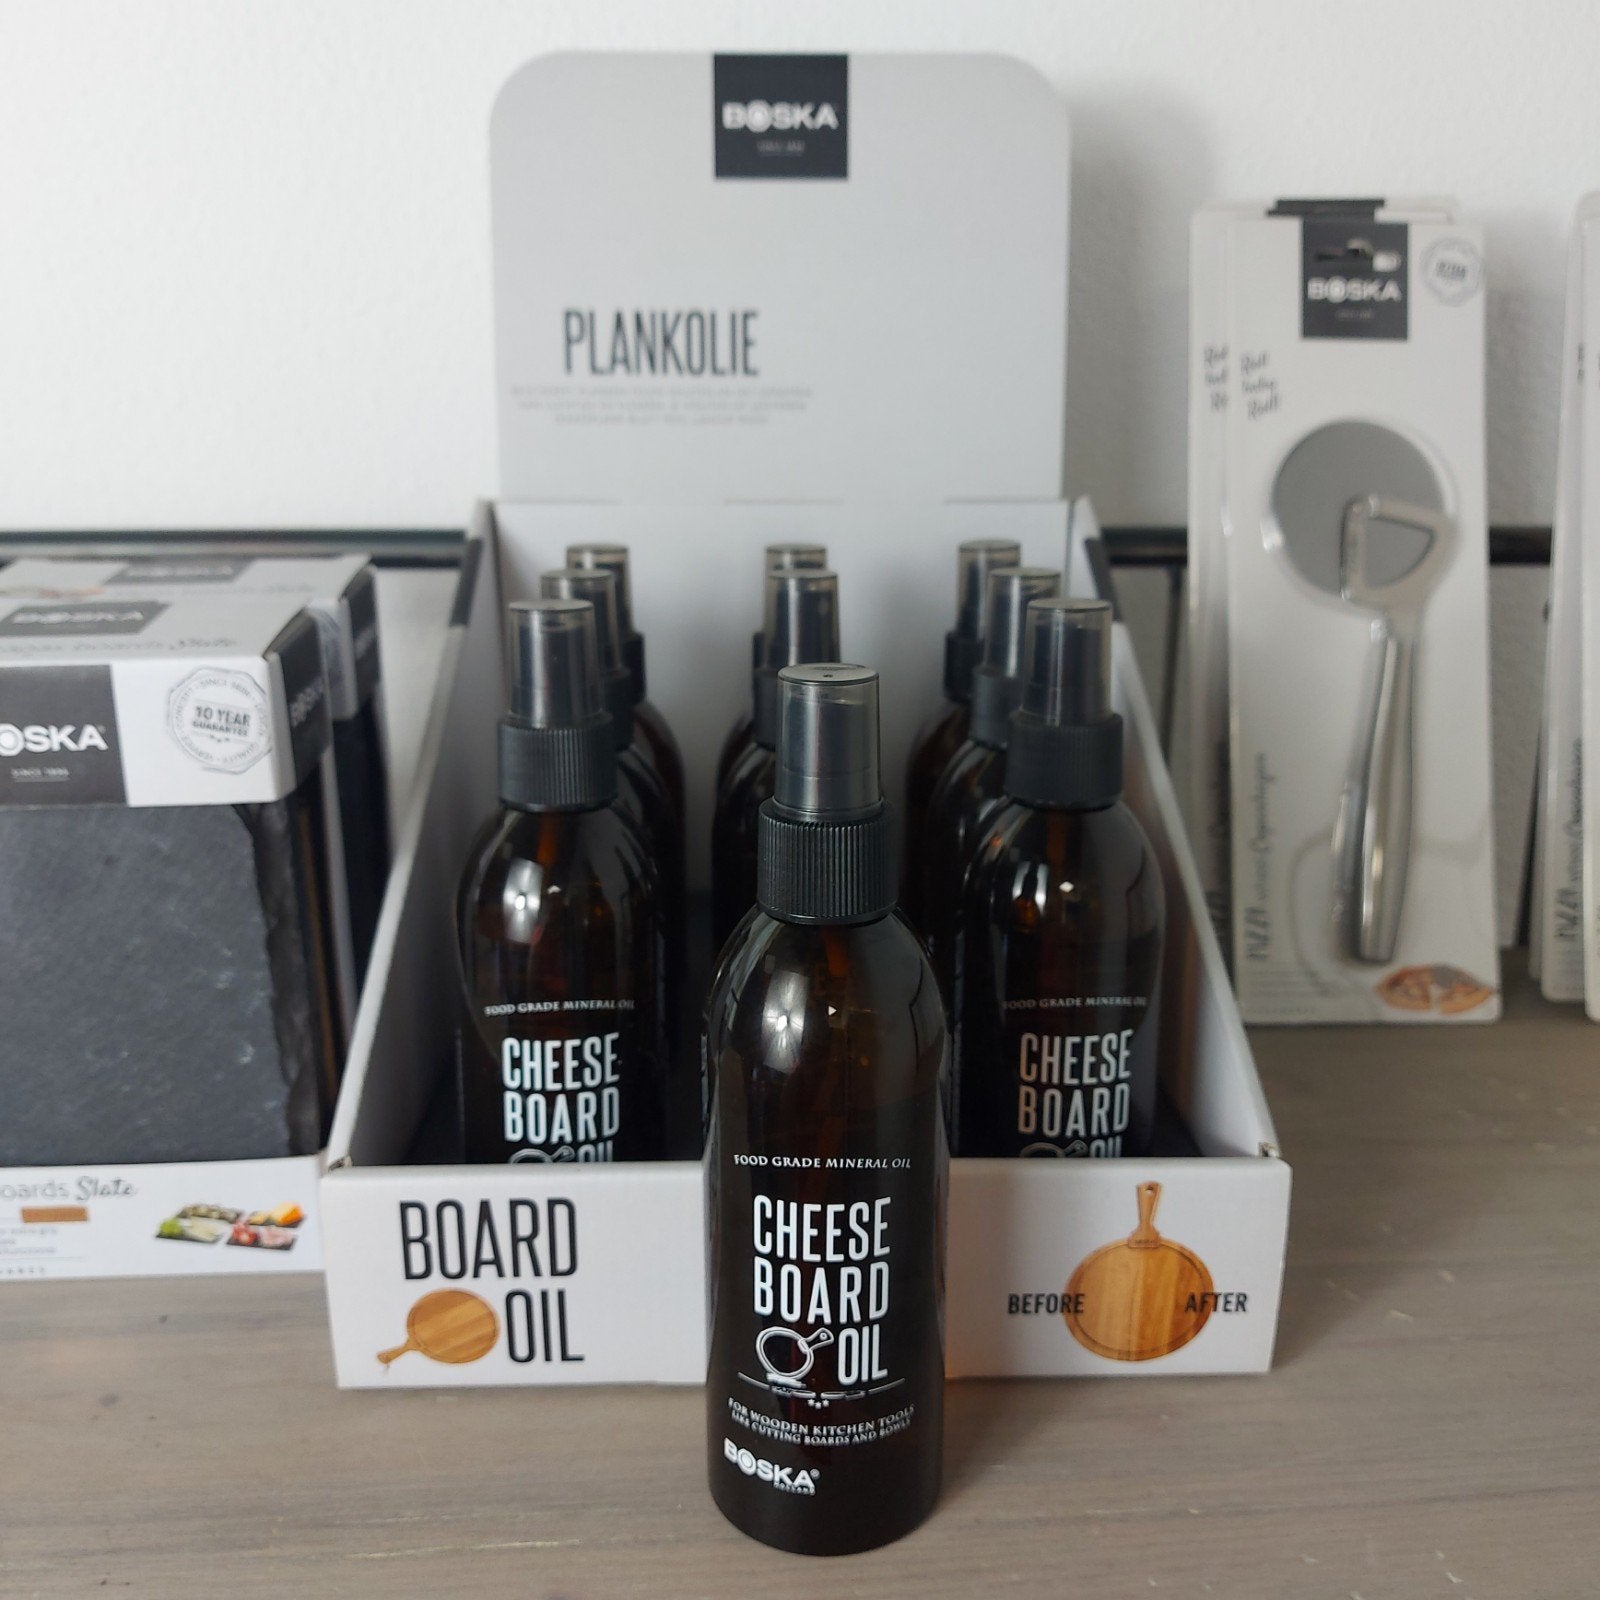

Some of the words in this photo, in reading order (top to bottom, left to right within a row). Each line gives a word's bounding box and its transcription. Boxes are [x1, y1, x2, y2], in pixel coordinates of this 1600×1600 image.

[722, 99, 839, 133] BOSKA
[1307, 276, 1402, 303] BOSKA
[564, 309, 759, 376] PLANKOLIE
[195, 705, 213, 720] 10
[217, 709, 251, 727] YEAR
[484, 1003, 515, 1017] FOOD
[517, 1001, 560, 1013] GRADE
[563, 1000, 616, 1011] MINERAL
[1039, 997, 1082, 1009] GRADE
[502, 1031, 620, 1091] CHEESE
[1019, 1028, 1134, 1086] CHEESE
[503, 1086, 620, 1145] BOARD
[1018, 1082, 1131, 1138] BOARD
[734, 1154, 768, 1166] FOOD
[771, 1156, 821, 1168] GRADE
[825, 1158, 888, 1168] MINERAL
[891, 1158, 911, 1168] OIL
[76, 1176, 138, 1201] Slate
[400, 1197, 578, 1280] BOARD
[753, 1194, 891, 1263] CHEESE
[753, 1256, 890, 1325] BOARD
[1007, 1293, 1085, 1314] BEFORE
[1184, 1292, 1248, 1313] AFTER
[505, 1288, 585, 1363] OIL
[837, 1323, 889, 1386] OIL
[728, 1397, 749, 1417] FOR
[750, 1410, 809, 1435] WOODEN
[813, 1420, 875, 1437] KITCHEN
[877, 1404, 915, 1428] TOOLS
[751, 1421, 801, 1445] CUTTING
[804, 1435, 850, 1447] BOARDS
[852, 1431, 878, 1445] AND
